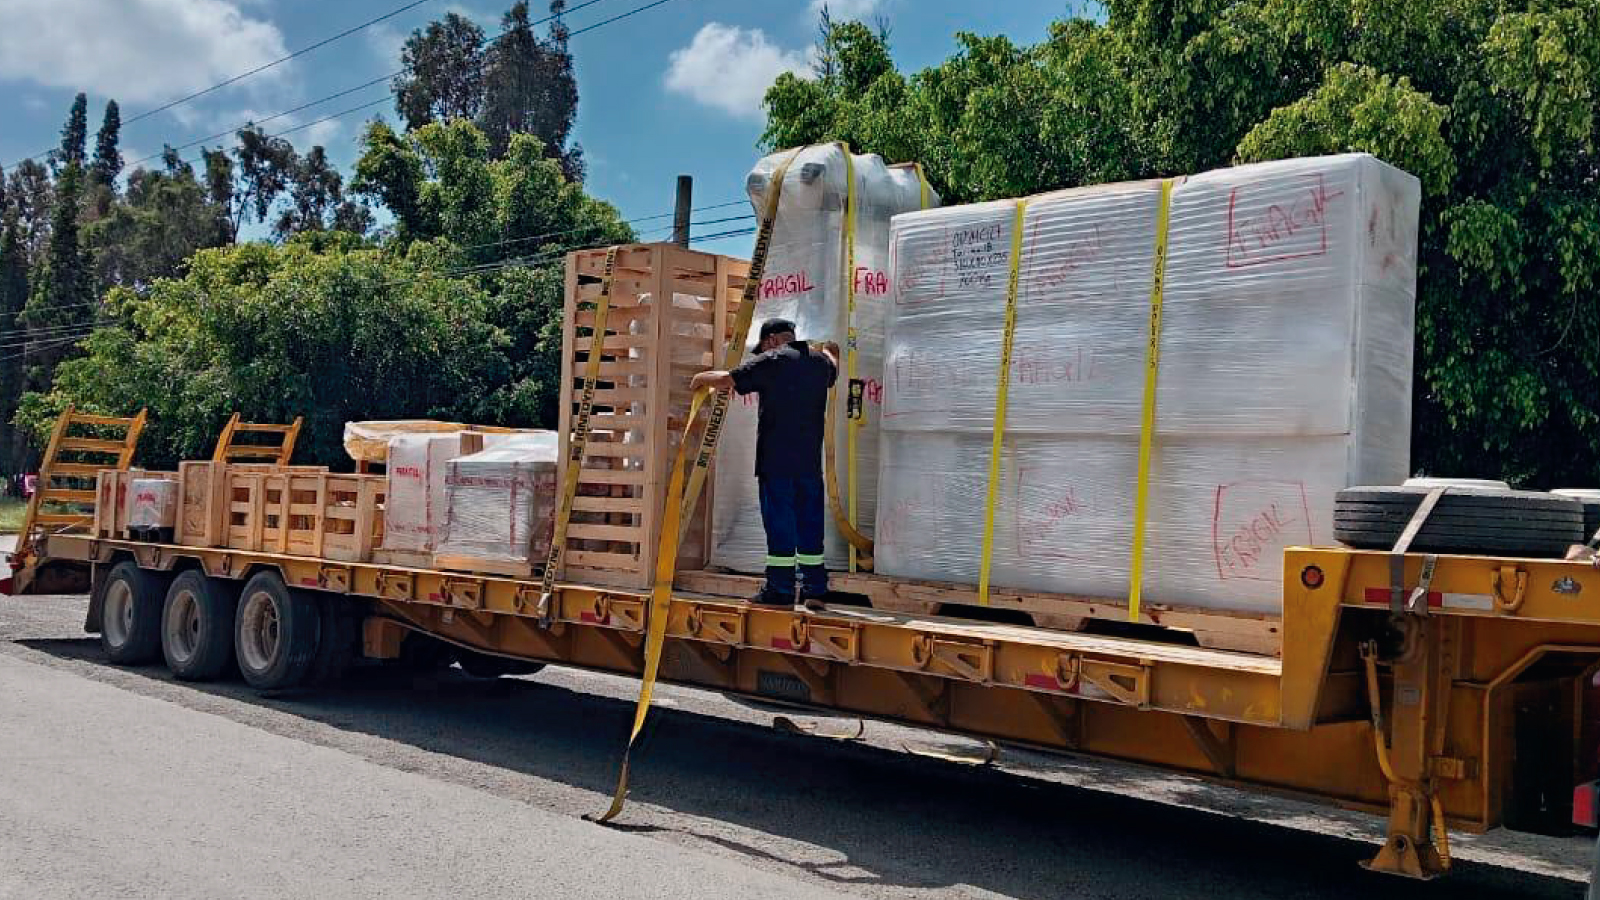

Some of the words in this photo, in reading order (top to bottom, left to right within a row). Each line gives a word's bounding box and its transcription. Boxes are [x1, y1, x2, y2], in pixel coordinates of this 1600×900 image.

[749, 217, 772, 277] KINEDYNE
[854, 266, 889, 298] FRA
[574, 376, 595, 442] KINEDYNE
[702, 386, 729, 448] KINEDYN
